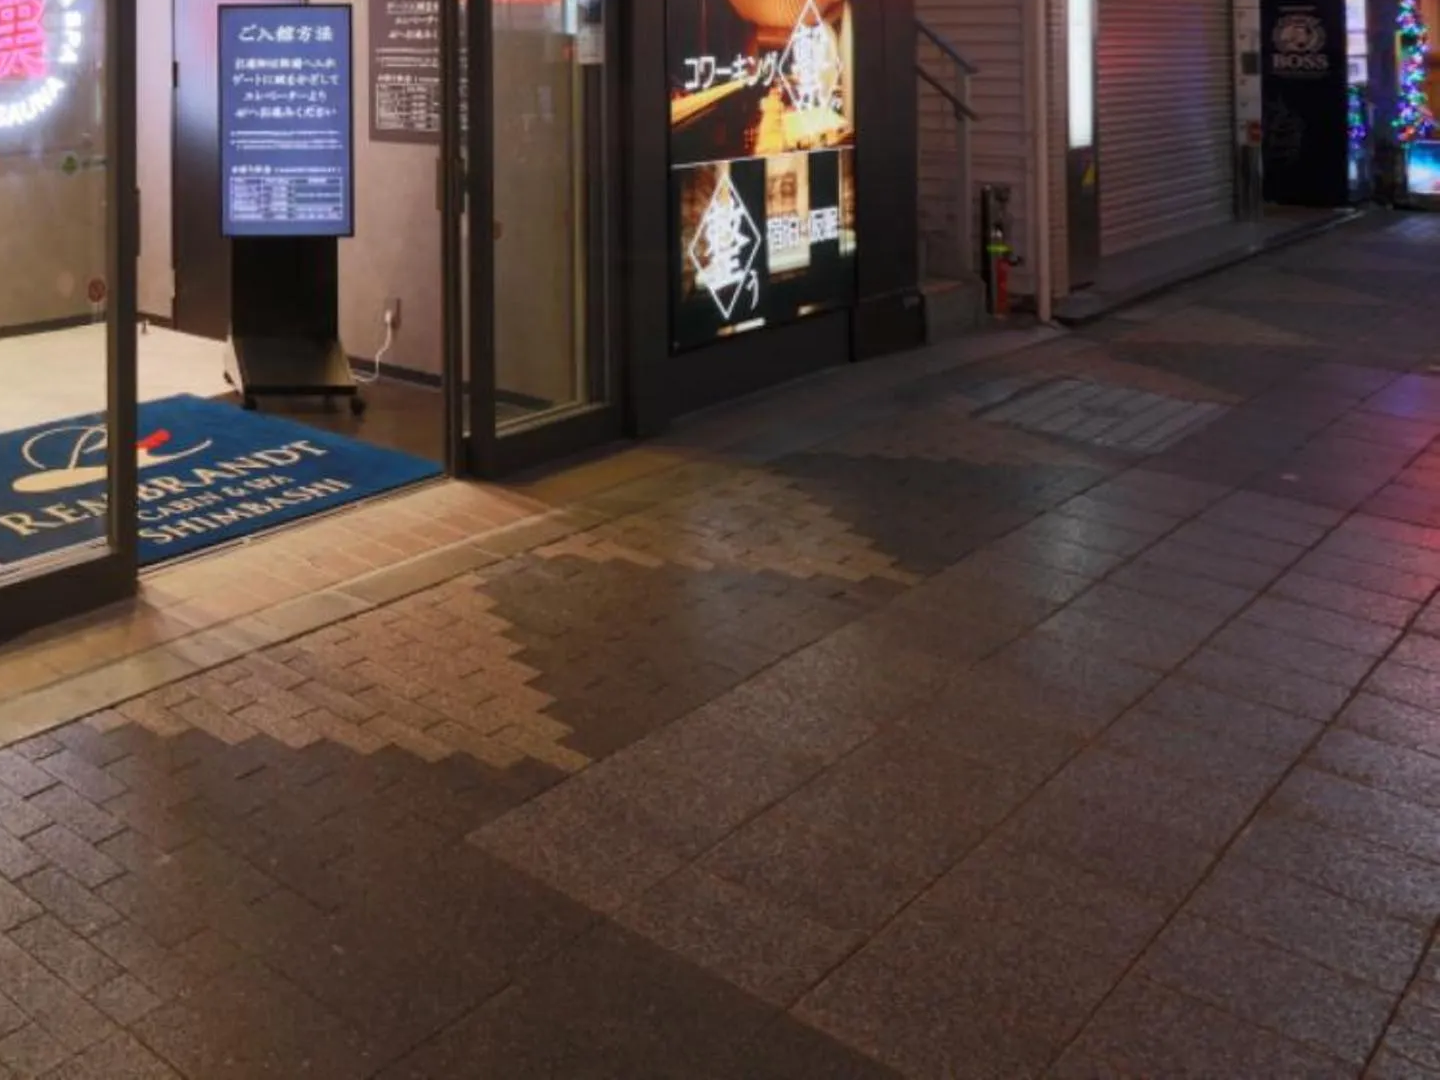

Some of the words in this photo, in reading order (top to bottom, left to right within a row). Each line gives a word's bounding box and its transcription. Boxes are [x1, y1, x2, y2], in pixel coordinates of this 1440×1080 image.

[684, 50, 778, 90] コワーキング
[1272, 53, 1329, 71] BOSS
[137, 478, 354, 545] SHIMBASHI
